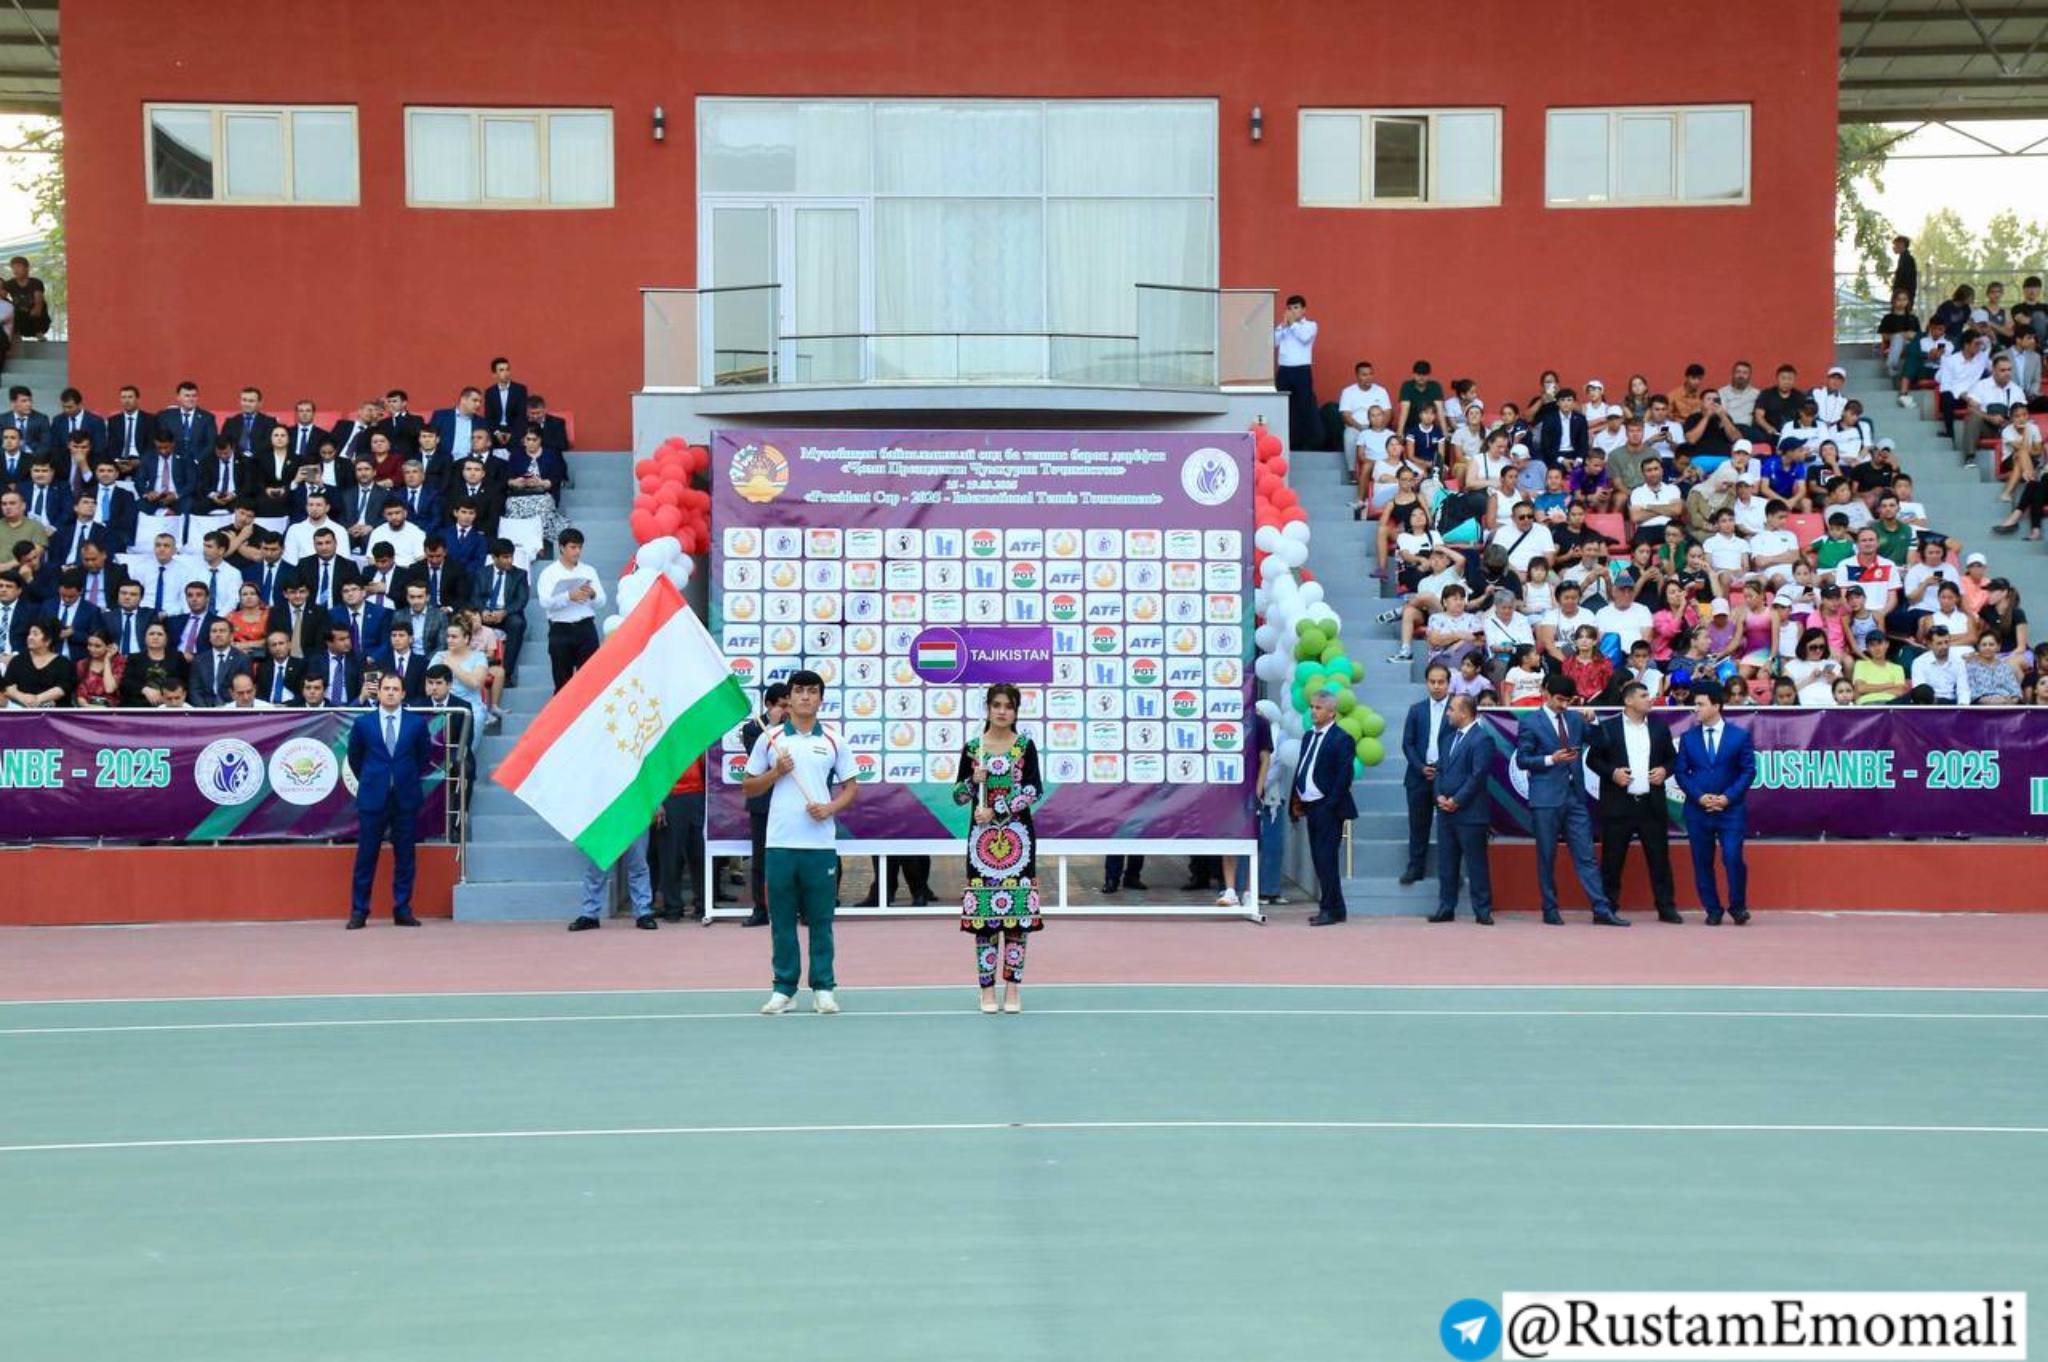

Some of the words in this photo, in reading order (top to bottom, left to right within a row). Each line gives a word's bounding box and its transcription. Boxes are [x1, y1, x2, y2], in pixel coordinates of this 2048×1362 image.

[1009, 541, 1042, 552] ATF
[1050, 573, 1082, 584] ATF
[1089, 605, 1121, 616] ATF
[727, 636, 760, 647] ATF
[1130, 638, 1162, 648] ATF
[971, 649, 1049, 661] TAJIKISTAN
[1170, 670, 1202, 680] ATF
[821, 702, 841, 712] TF
[1210, 702, 1242, 713] ATF
[848, 734, 881, 744] ATF
[95, 749, 171, 788] 2025
[888, 766, 921, 777] ATF
[1926, 750, 2000, 789] 2025
